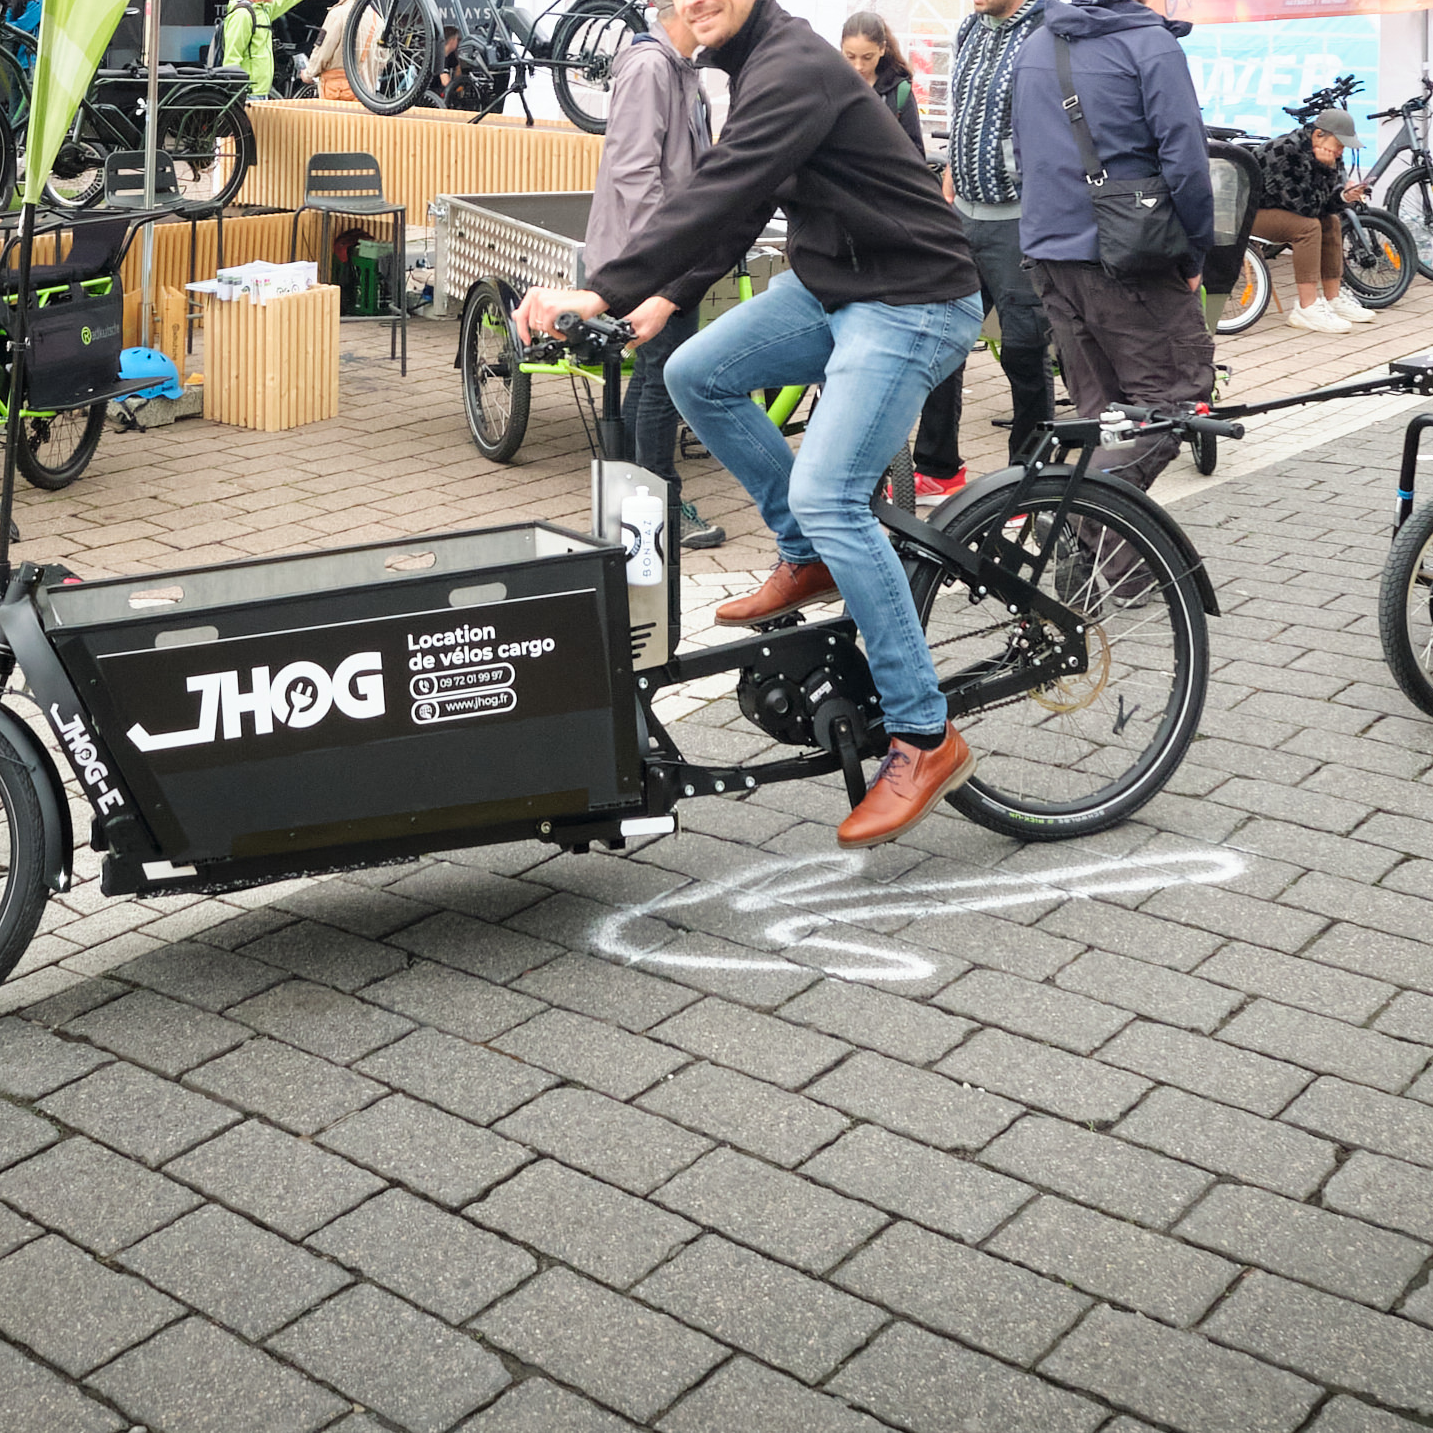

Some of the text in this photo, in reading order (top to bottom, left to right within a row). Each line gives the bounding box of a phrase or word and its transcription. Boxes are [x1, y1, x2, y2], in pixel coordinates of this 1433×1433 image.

[407, 624, 496, 651] Location
[408, 637, 556, 671] de vélos cargo
[440, 670, 504, 688] 09 72 01 99 97
[126, 651, 386, 753] JHOG
[445, 693, 509, 713] www.jhog.fr
[50, 702, 125, 816] JHOG-E
